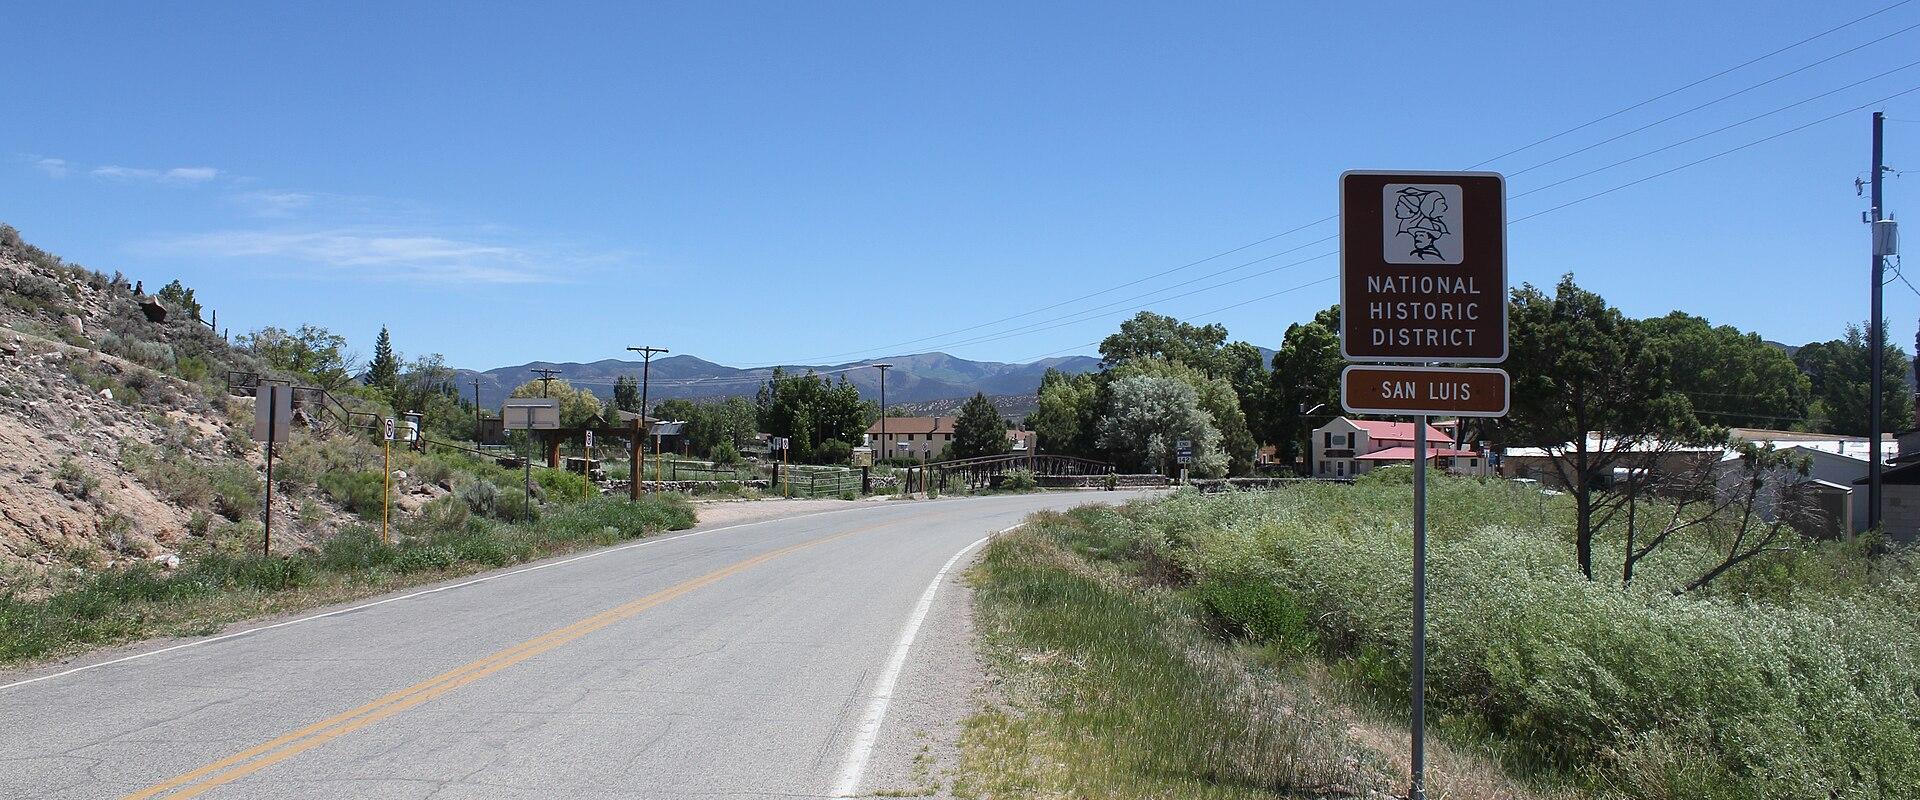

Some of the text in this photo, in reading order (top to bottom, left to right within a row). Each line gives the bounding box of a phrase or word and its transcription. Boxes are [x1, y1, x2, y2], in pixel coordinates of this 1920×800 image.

[1367, 275, 1481, 294] NATIONAL
[1370, 302, 1479, 320] HISTORIC
[1372, 328, 1476, 346] DISTRICT
[1381, 380, 1471, 401] SAN LUIS
